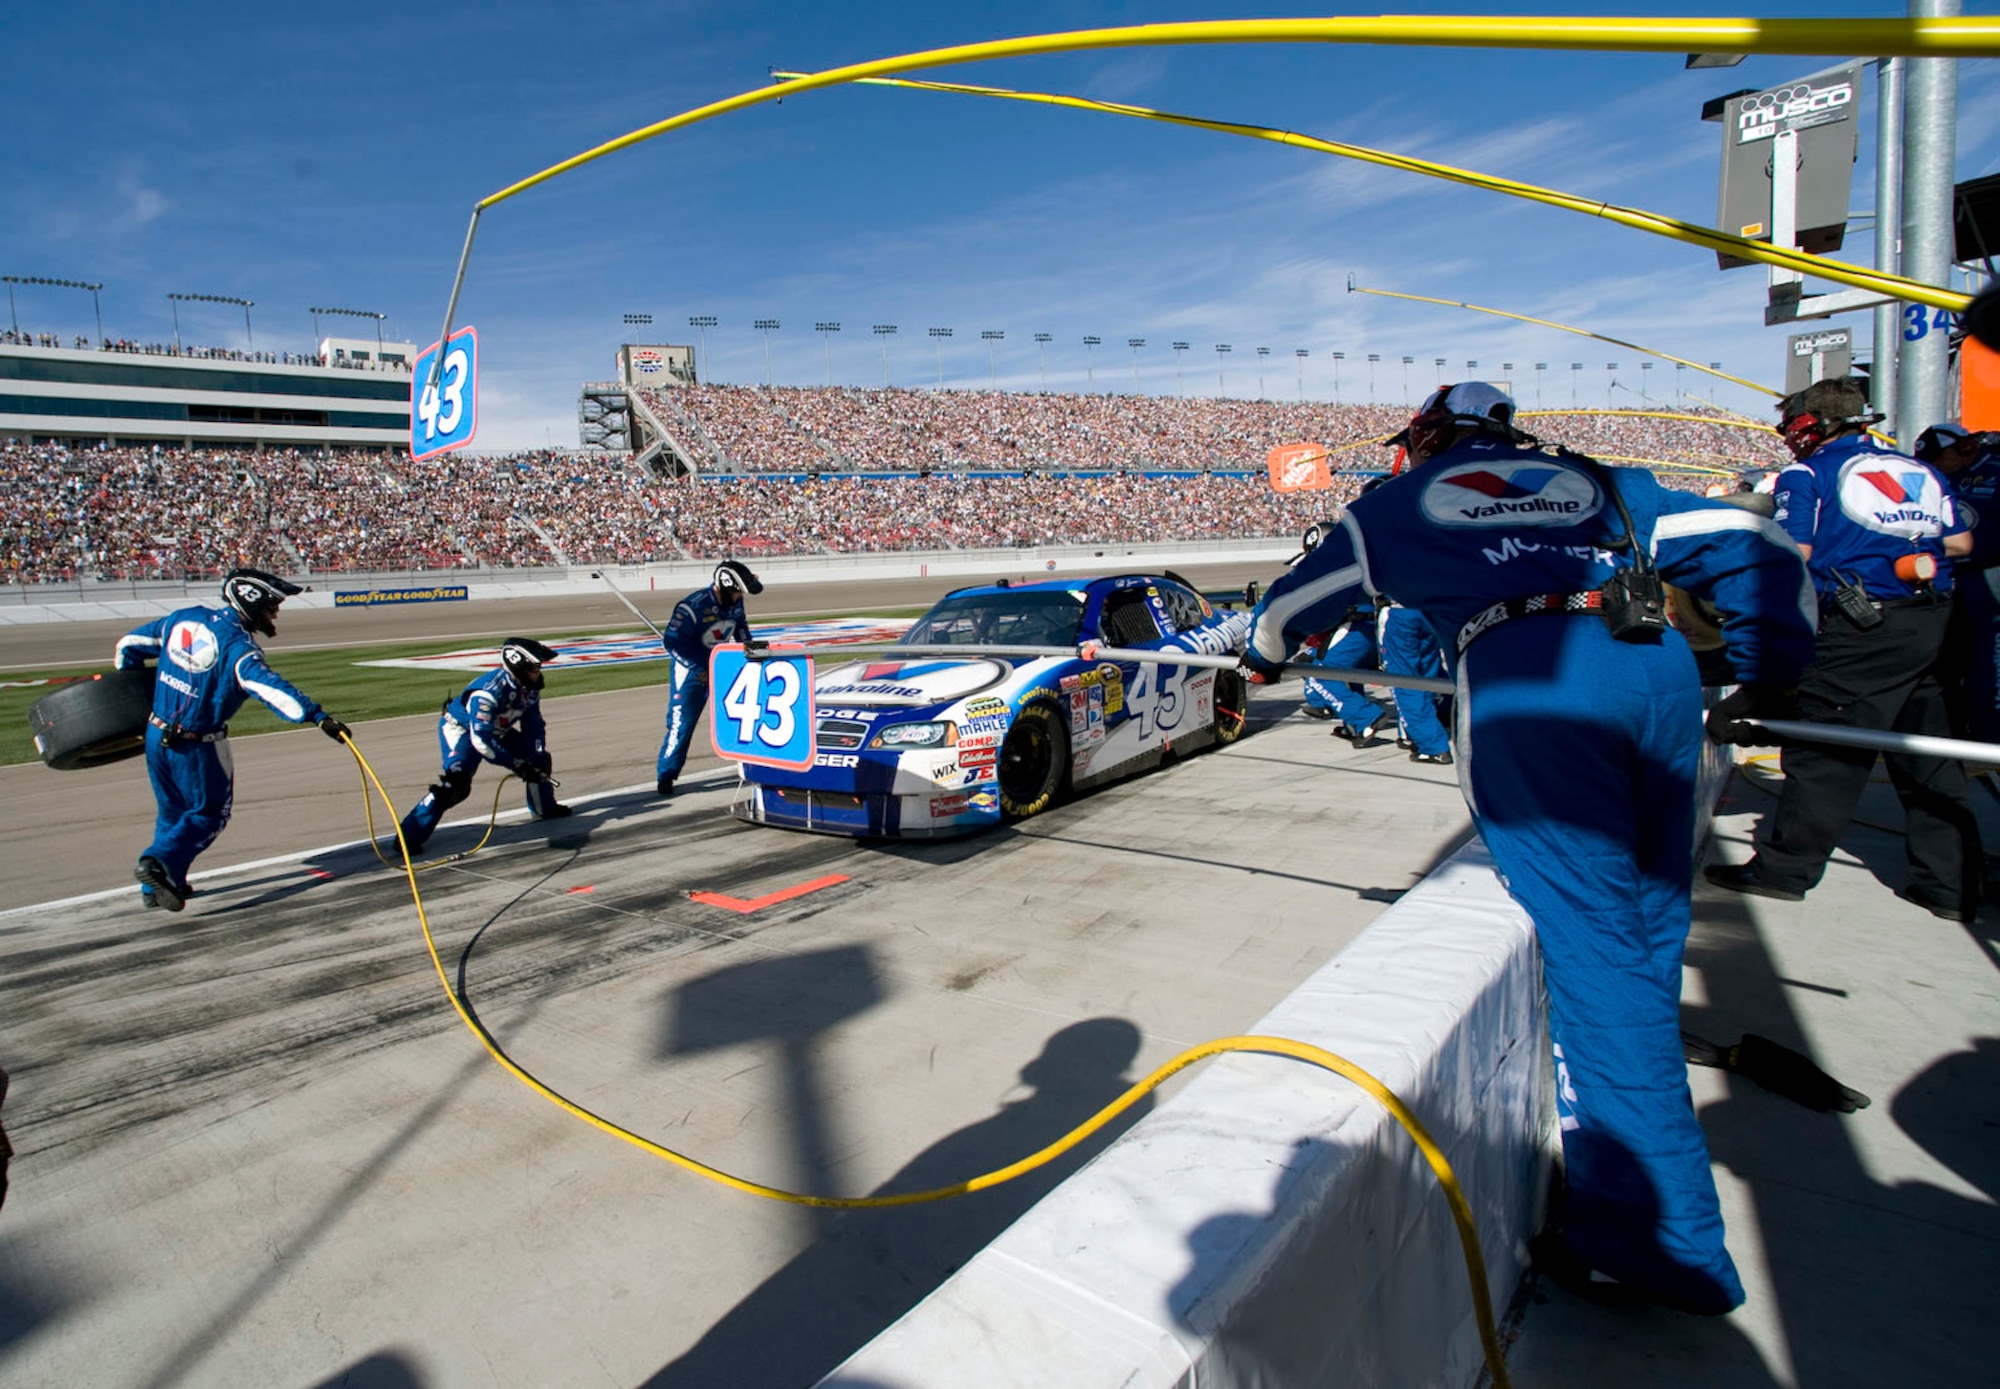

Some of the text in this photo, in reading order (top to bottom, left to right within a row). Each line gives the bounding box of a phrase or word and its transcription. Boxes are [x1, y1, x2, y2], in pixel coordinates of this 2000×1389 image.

[1904, 303, 1949, 342] 34
[418, 347, 468, 443] 43
[1460, 498, 1580, 519] Valvoline
[720, 571, 733, 587] 43
[237, 583, 262, 602] 43
[336, 586, 465, 604] GOODYEAR GOODYEAR
[505, 649, 521, 664] 43
[1072, 690, 1087, 710] 3M
[1126, 645, 1187, 741] 43
[724, 659, 801, 748] 43
[959, 719, 1006, 736] MAHLE
[958, 736, 993, 749] COMP
[933, 762, 957, 779] WIX
[964, 766, 994, 784] JE
